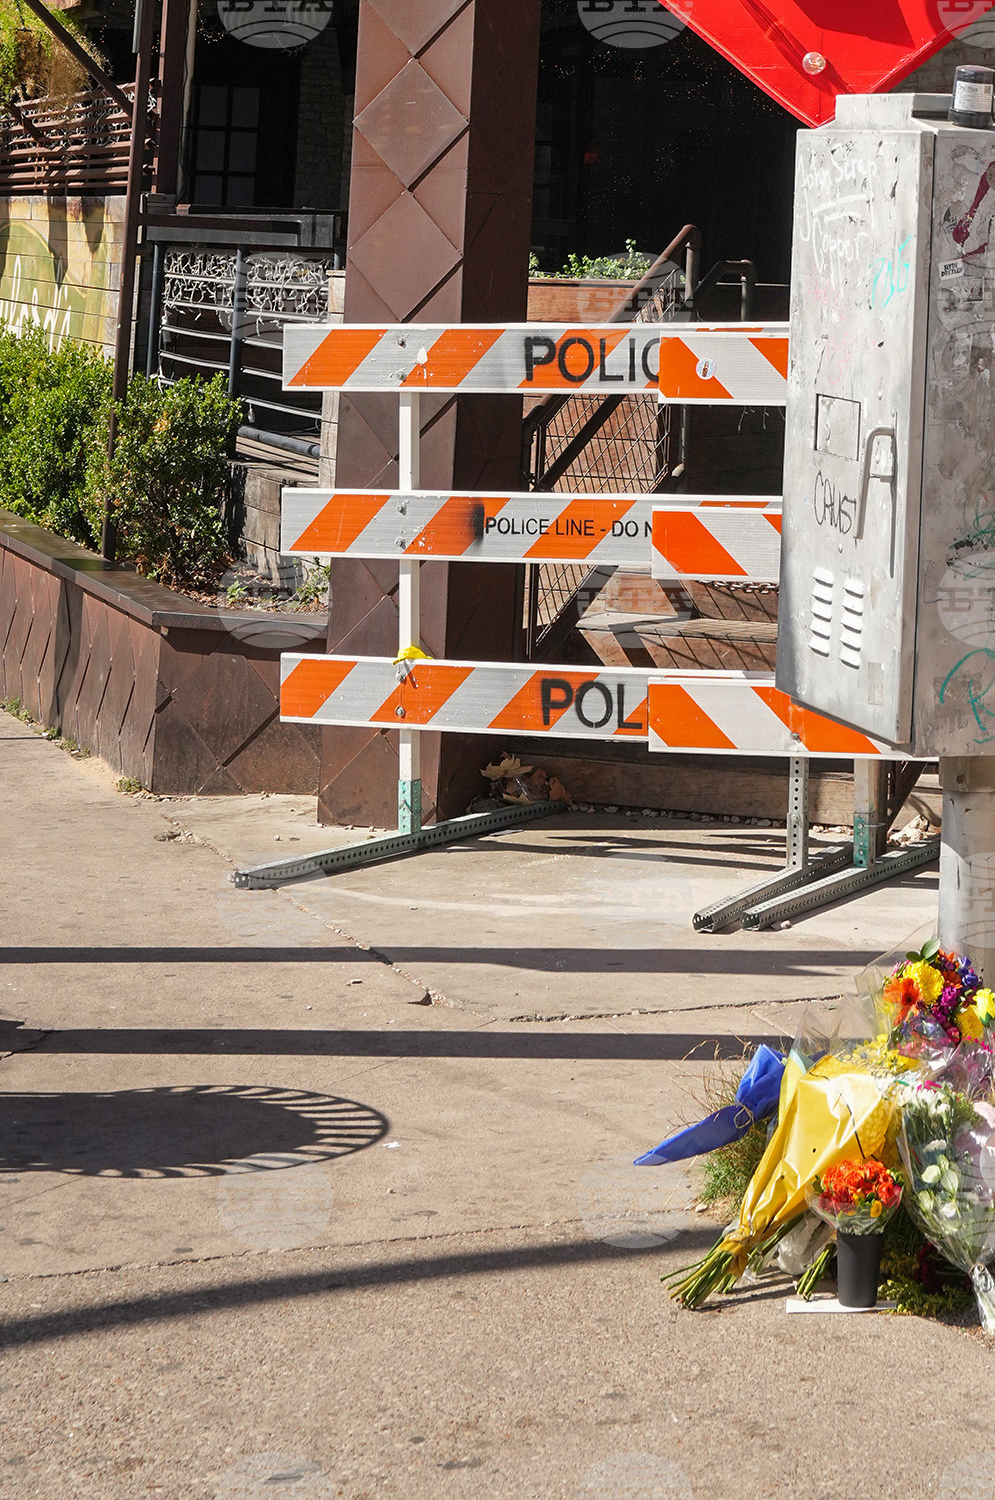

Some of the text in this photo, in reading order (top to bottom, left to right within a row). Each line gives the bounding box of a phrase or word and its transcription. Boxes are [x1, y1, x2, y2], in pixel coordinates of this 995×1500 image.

[485, 516, 550, 535] POLICE
[556, 519, 595, 536] LINE
[611, 520, 639, 537] DO
[541, 678, 643, 729] POL
